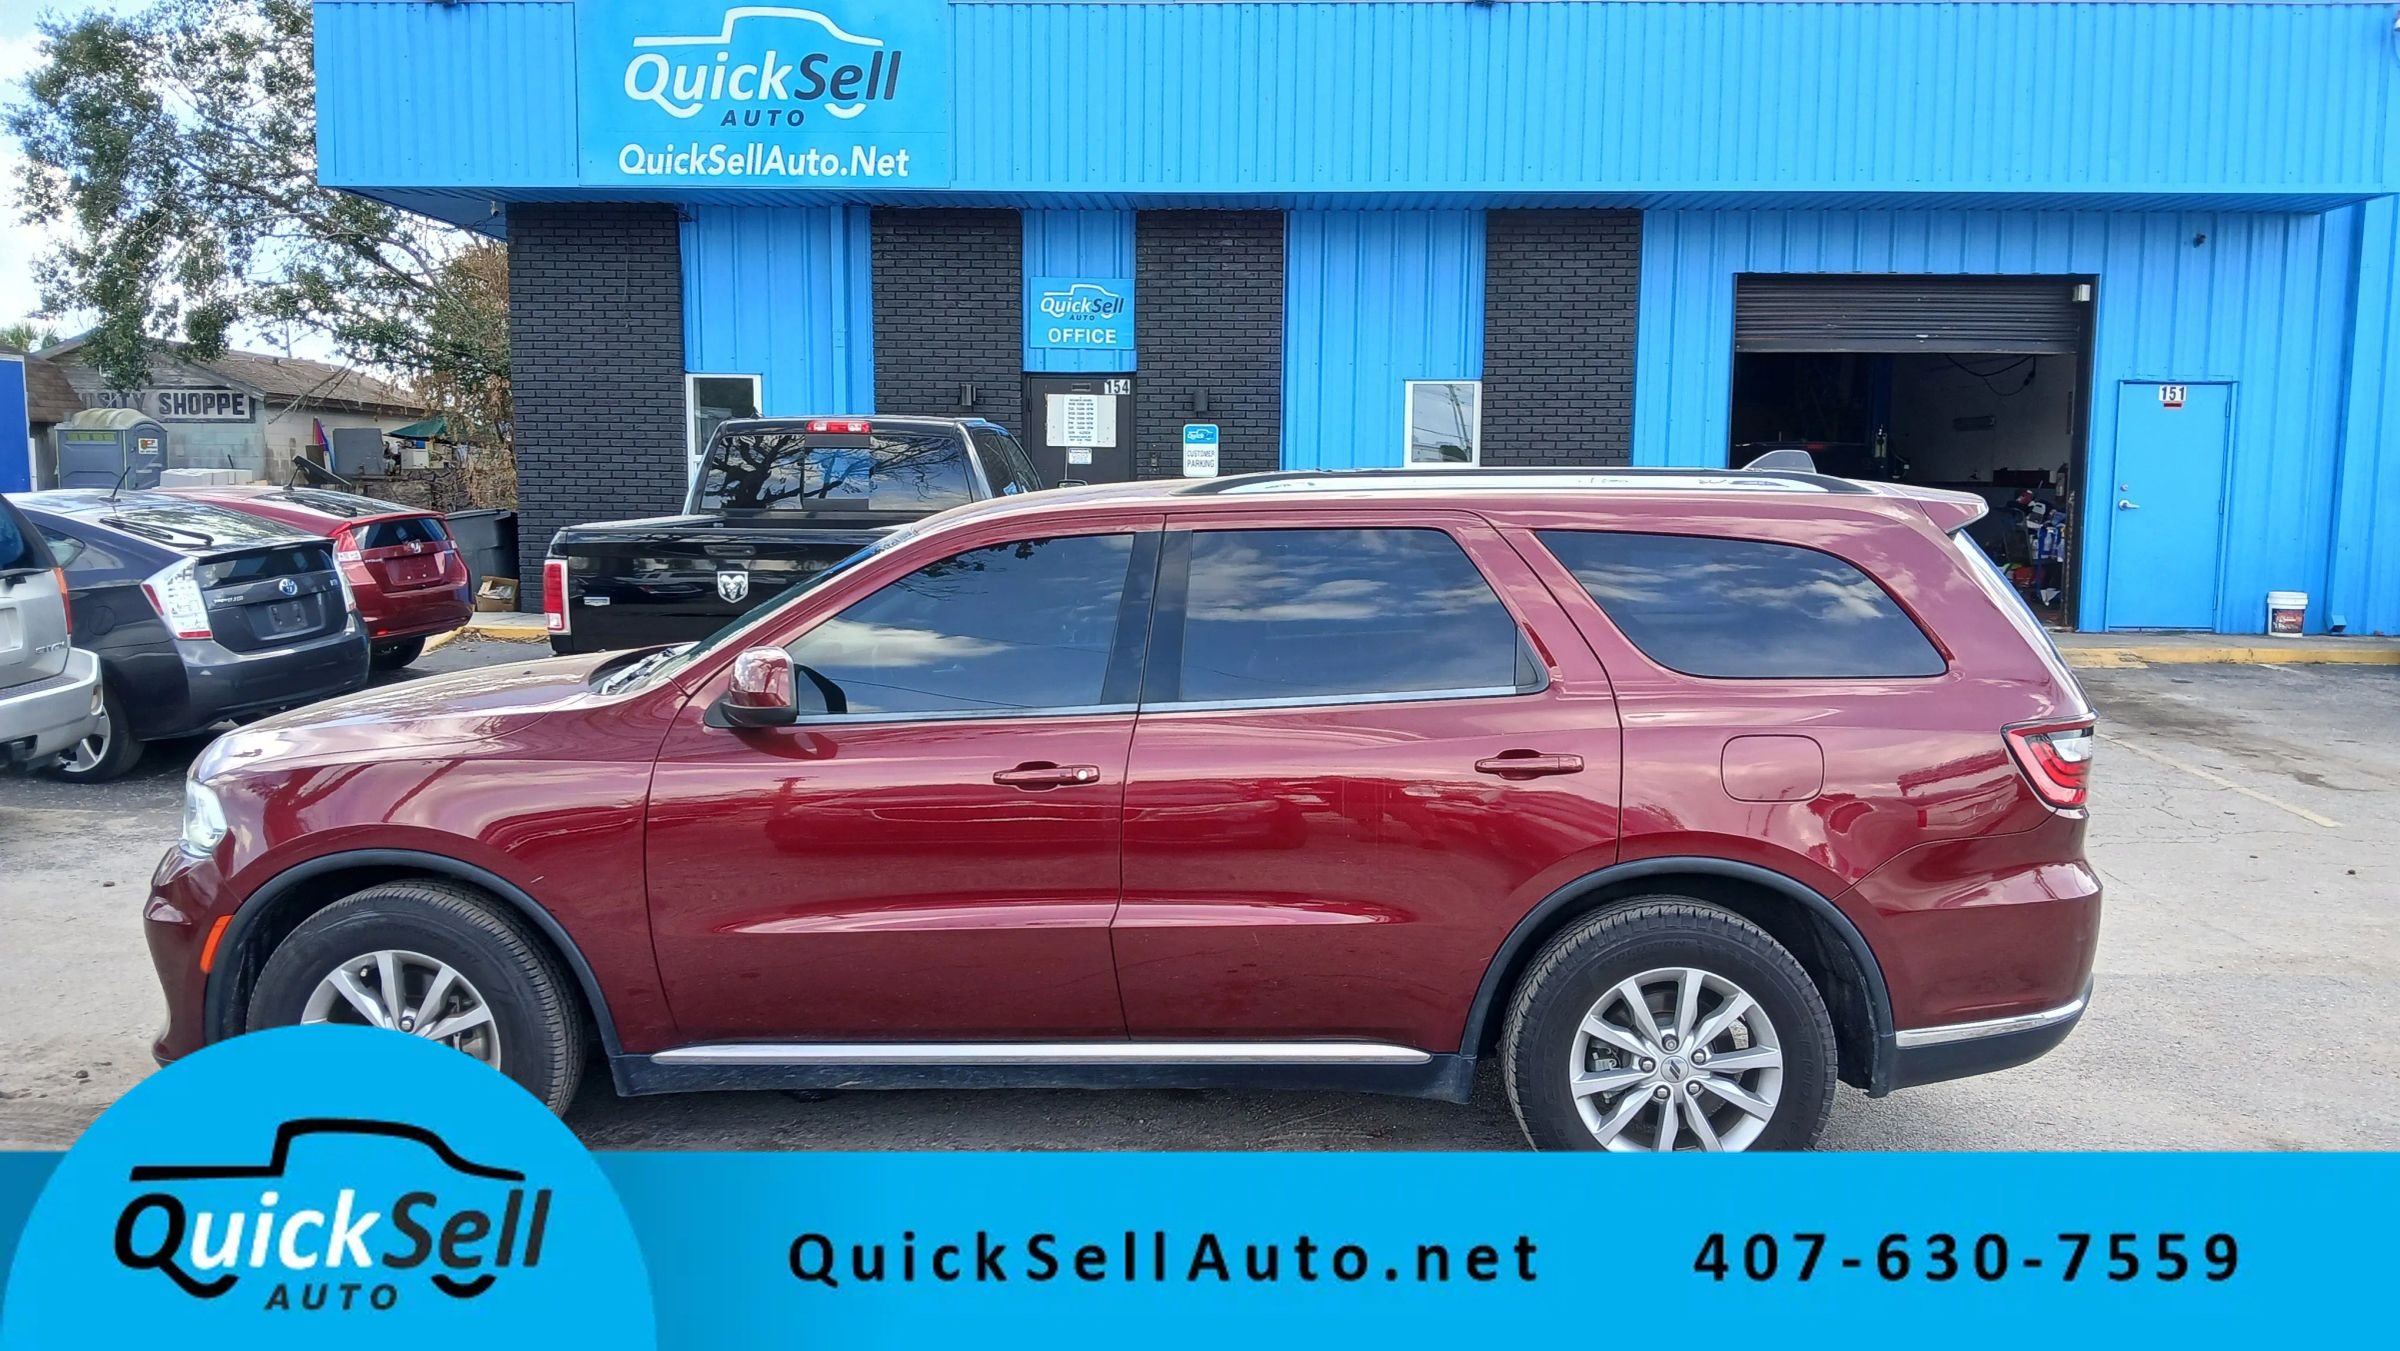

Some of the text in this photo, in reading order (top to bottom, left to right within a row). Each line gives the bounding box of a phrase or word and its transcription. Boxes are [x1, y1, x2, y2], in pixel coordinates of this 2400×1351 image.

[623, 50, 903, 119] QuickSell
[720, 109, 806, 127] AUTO
[618, 143, 910, 177] QuickSellAuto.Net
[1040, 297, 1125, 318] QuickSell
[1048, 327, 1117, 345] OFFICE
[1107, 380, 1129, 394] 154
[2161, 386, 2185, 401] 151
[158, 392, 245, 416] SHOPPE
[1186, 459, 1215, 468] PARKING
